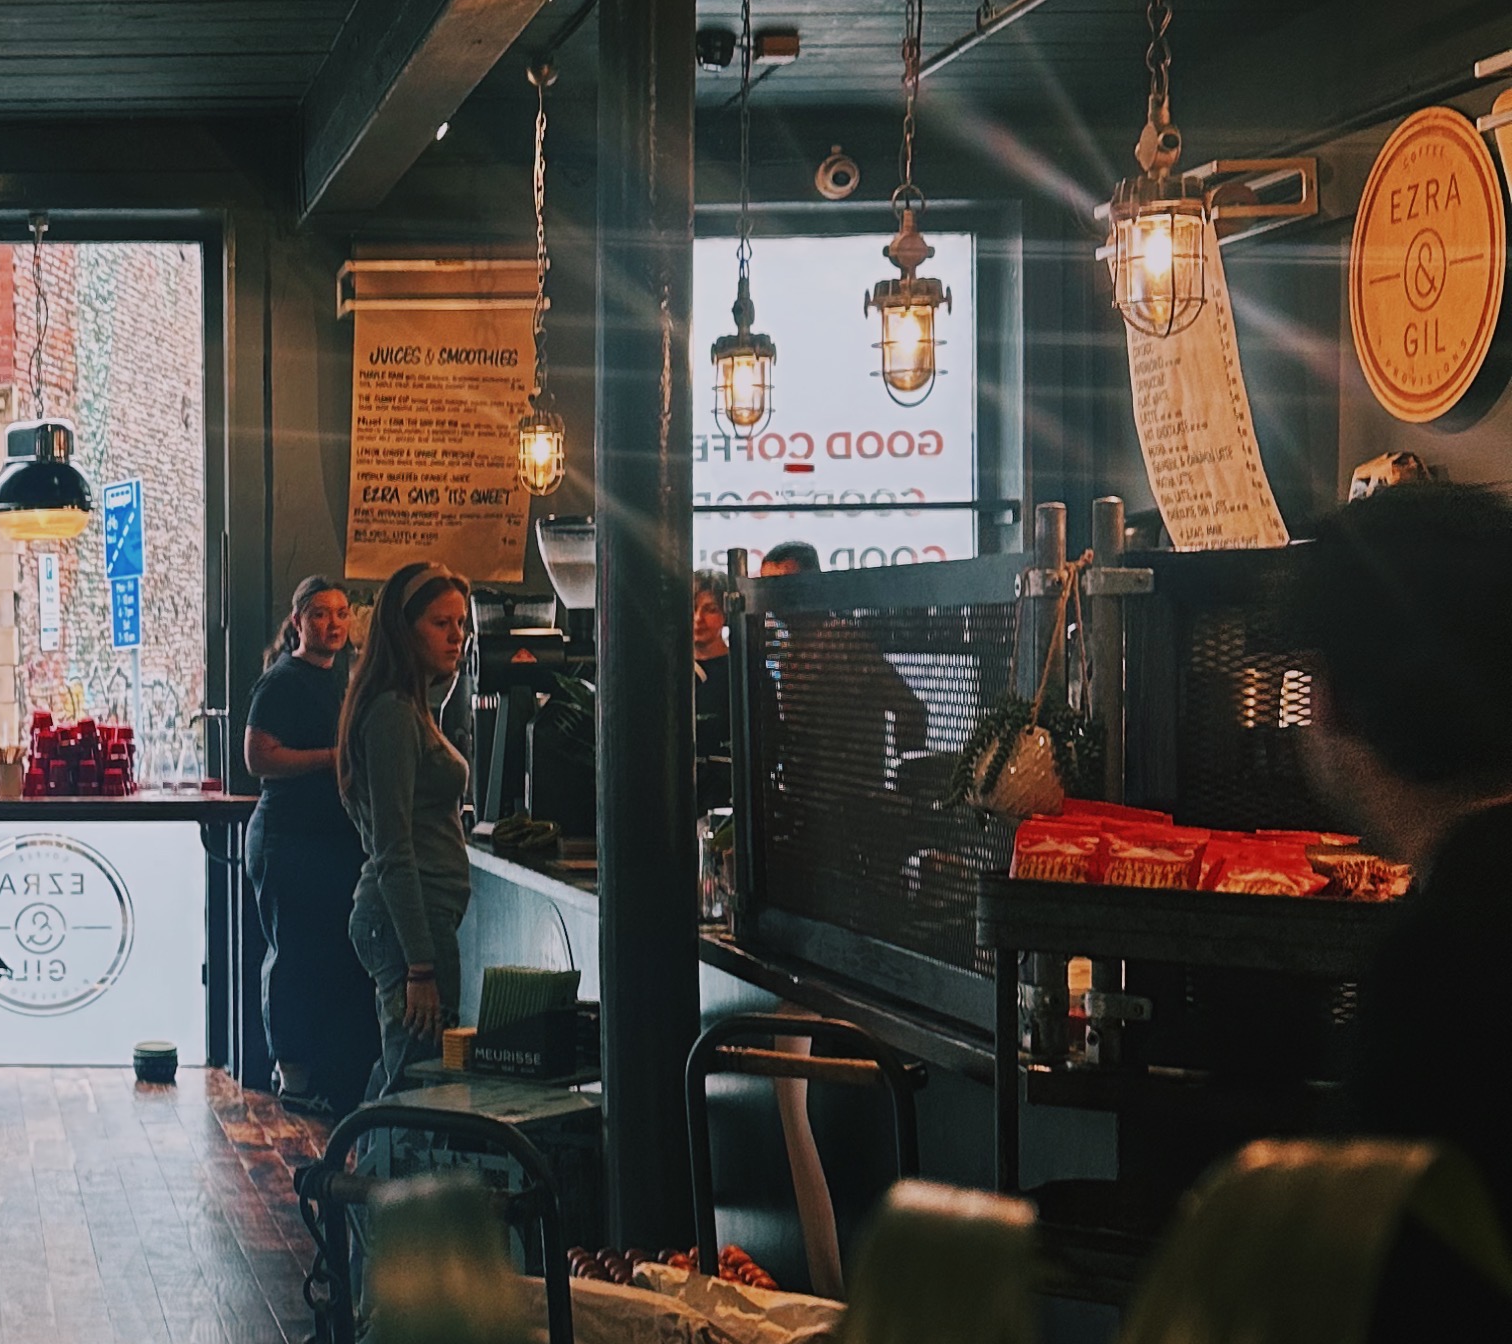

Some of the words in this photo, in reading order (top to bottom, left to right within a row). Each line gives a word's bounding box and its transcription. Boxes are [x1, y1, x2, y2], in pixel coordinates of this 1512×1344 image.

[1390, 172, 1461, 225] EZRA
[1414, 241, 1438, 297] &
[1404, 318, 1446, 358] GIL
[369, 345, 421, 366] JUICES
[425, 348, 435, 365] &
[437, 346, 518, 368] SMOOTHIES
[363, 486, 400, 504] EZRA
[407, 486, 440, 505] SAYS
[474, 1046, 542, 1067] MEURISSE
